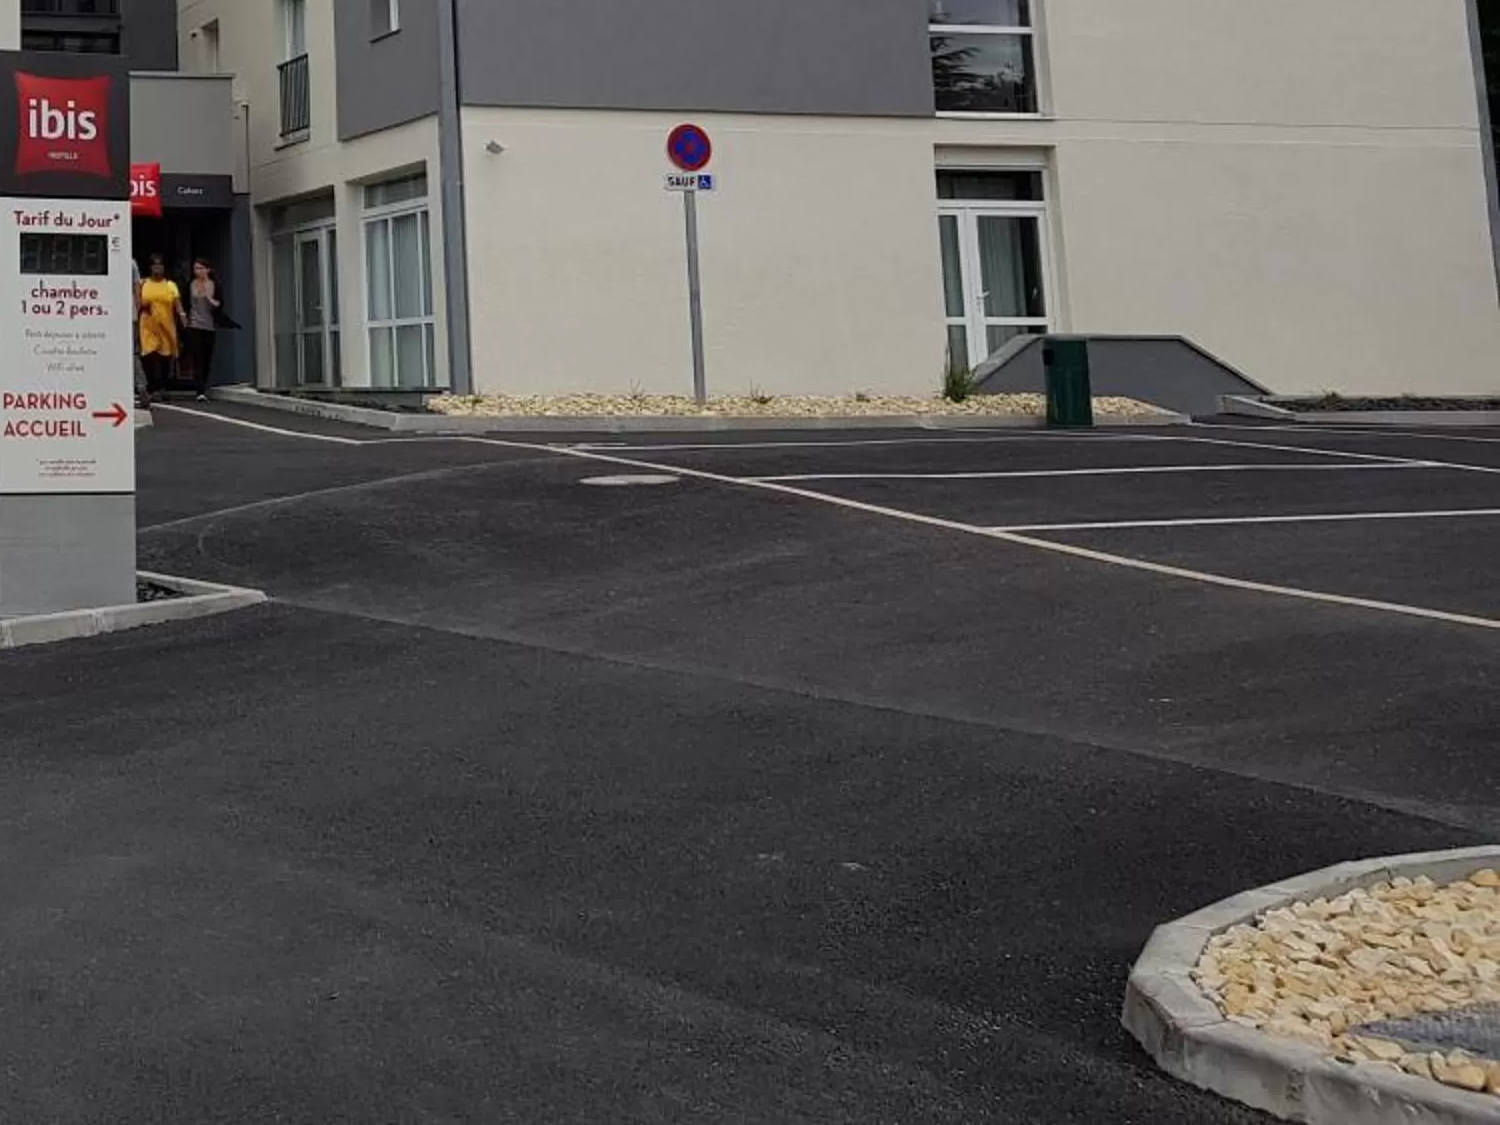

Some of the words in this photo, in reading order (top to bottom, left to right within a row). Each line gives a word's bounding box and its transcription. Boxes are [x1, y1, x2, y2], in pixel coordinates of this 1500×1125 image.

[29, 98, 97, 140] ibis
[130, 174, 157, 197] is
[667, 176, 696, 187] SAUF
[14, 210, 50, 226] Tarif
[53, 211, 73, 227] du
[31, 279, 99, 299] chambre
[21, 300, 28, 314] 1
[32, 304, 51, 315] ou
[56, 300, 65, 315] 2
[70, 304, 109, 319] pers.
[3, 392, 88, 410] PARKING
[3, 421, 88, 438] ACCUEIL
